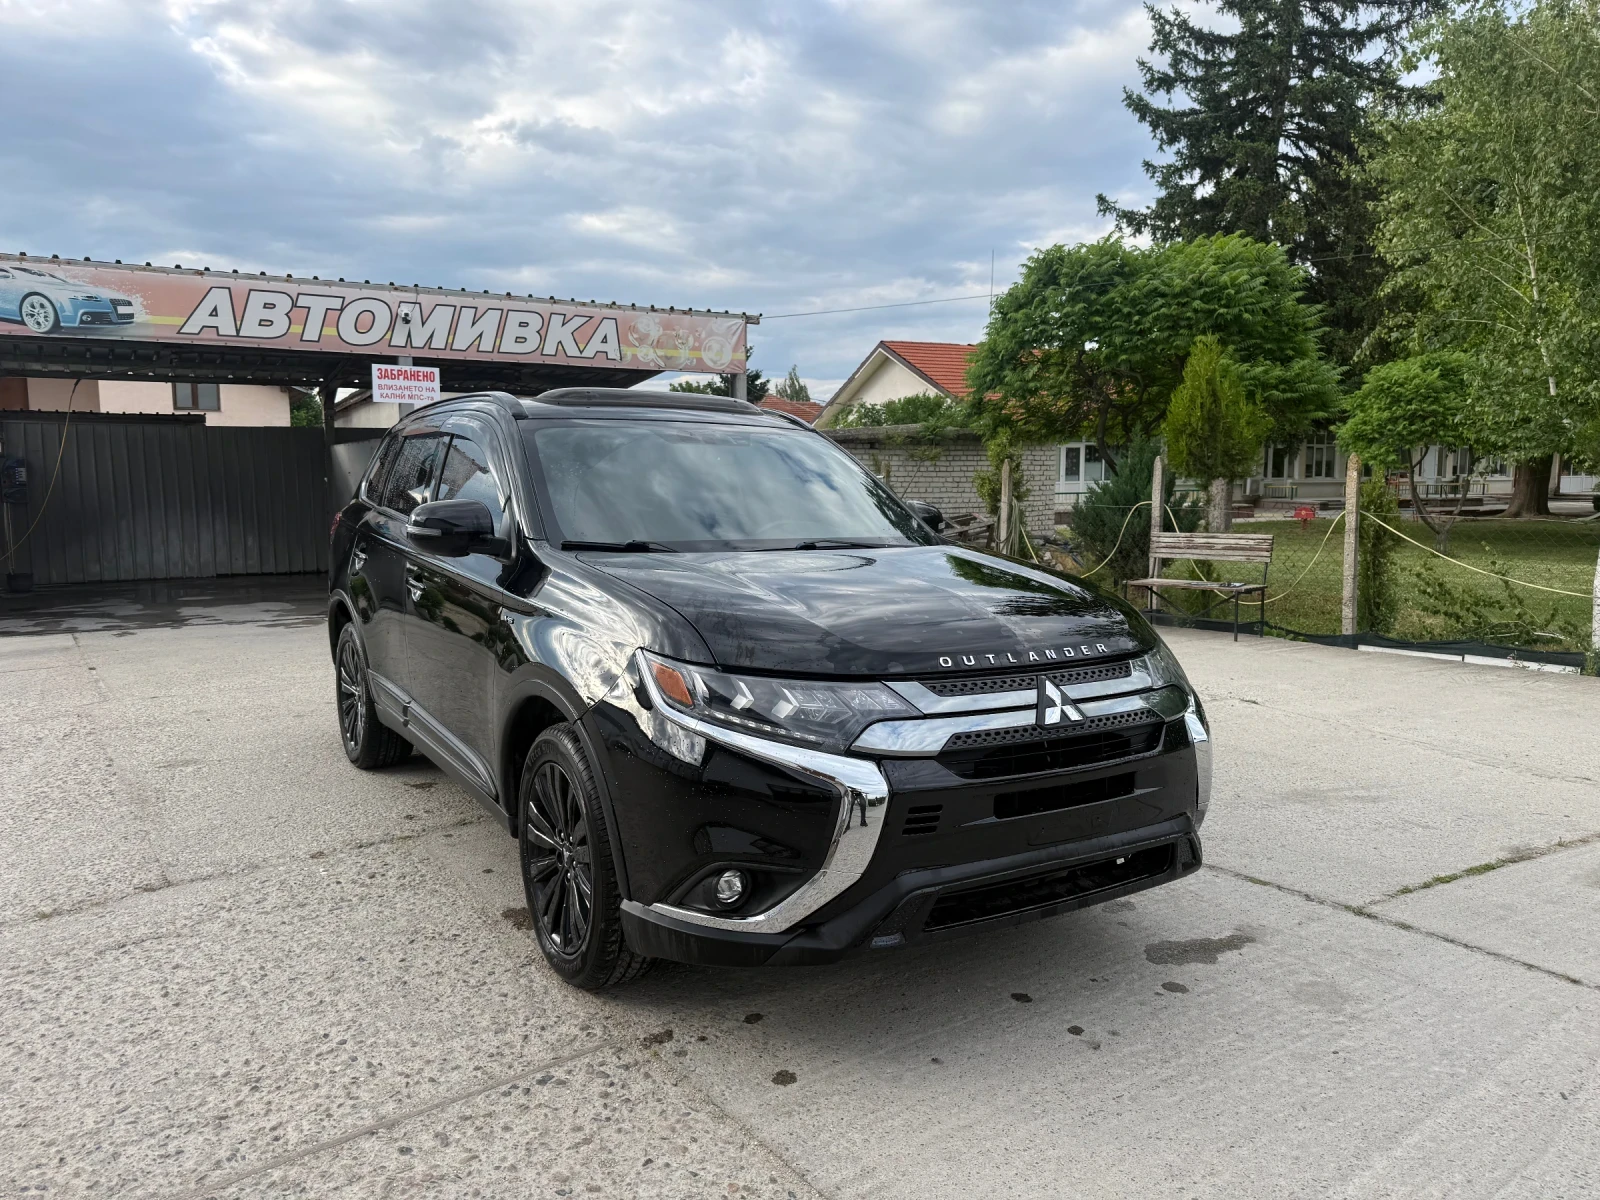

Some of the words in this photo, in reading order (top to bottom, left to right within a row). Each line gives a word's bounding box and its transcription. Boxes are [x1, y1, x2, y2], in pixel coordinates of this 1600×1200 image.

[177, 286, 622, 362] АВТОМИВКА
[377, 368, 435, 382] ЗАБРАНЕНО
[378, 384, 423, 392] ВЛИЗАНЕТО
[939, 643, 1108, 667] OUTLANDER
